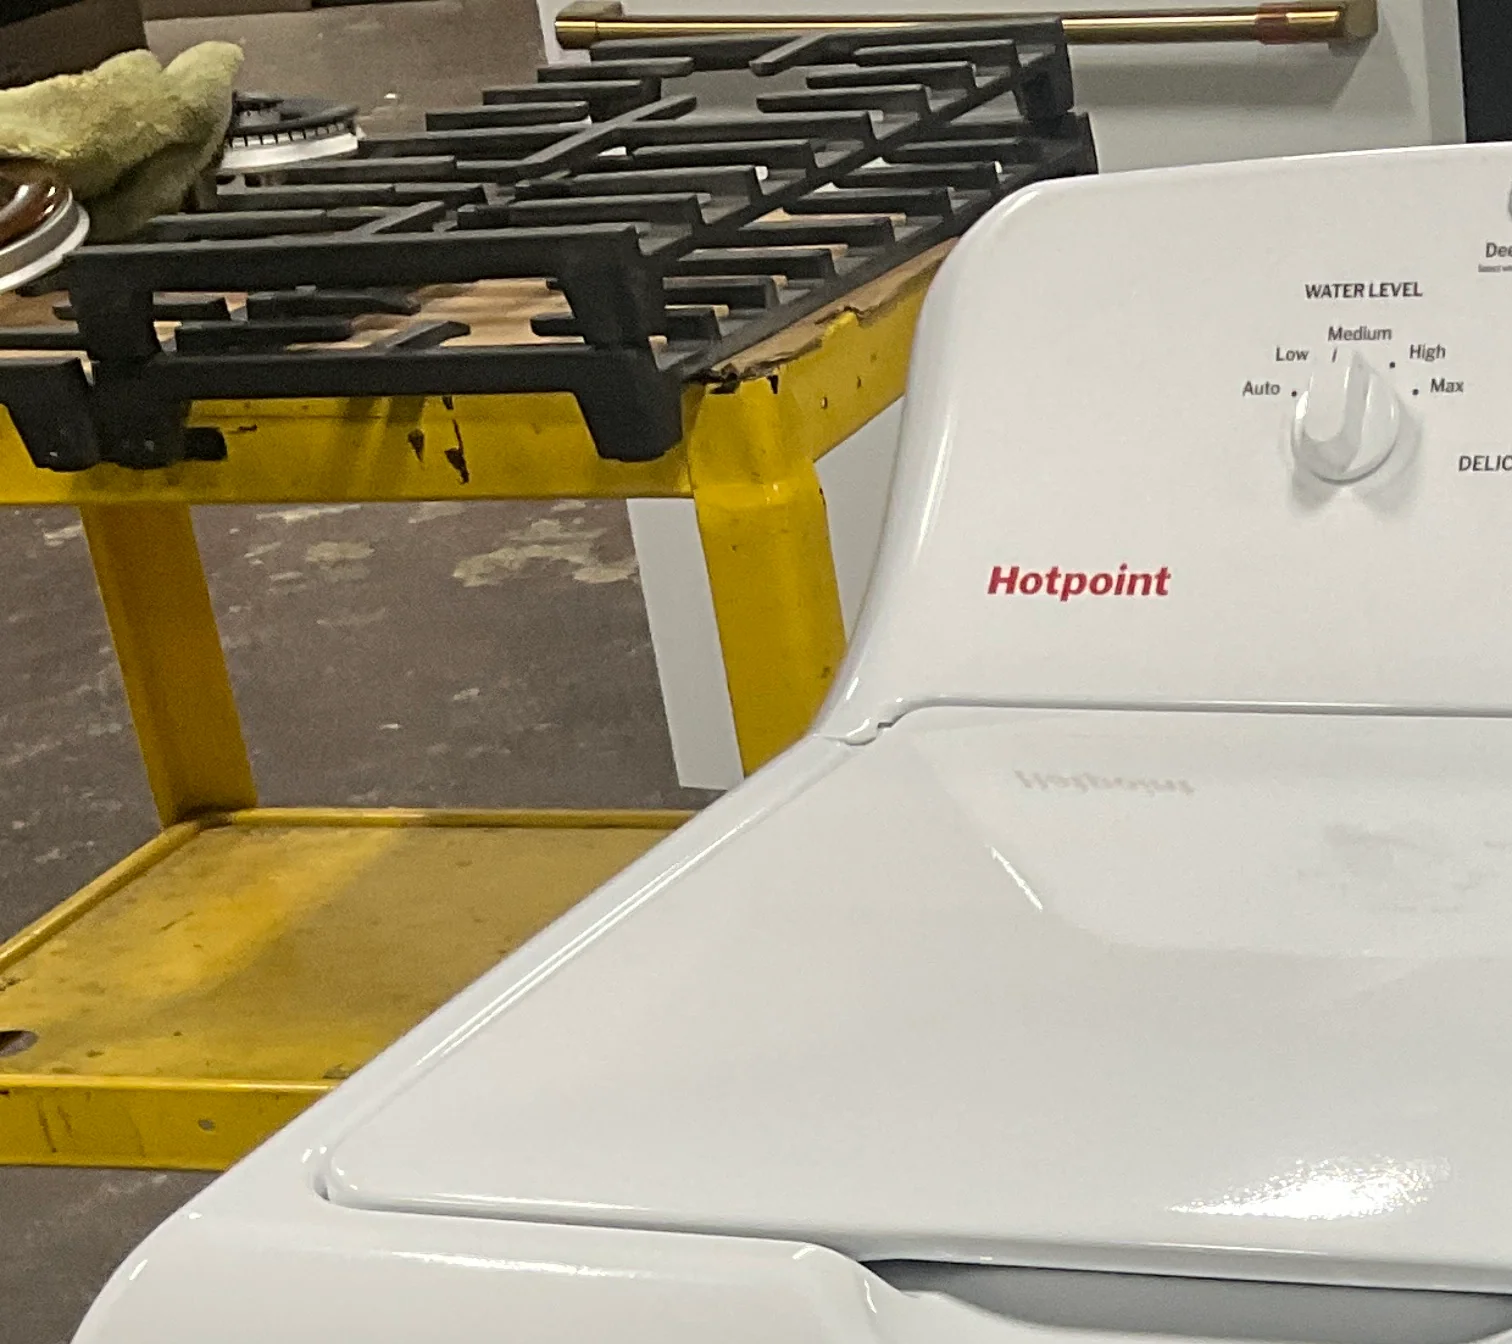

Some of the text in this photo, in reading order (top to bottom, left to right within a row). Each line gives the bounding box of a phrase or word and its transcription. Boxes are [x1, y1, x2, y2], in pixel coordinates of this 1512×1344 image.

[1304, 281, 1424, 300] WATER LEVEL
[1327, 325, 1393, 342] Medium
[1275, 346, 1310, 362] Low
[1409, 343, 1446, 363] High
[1242, 380, 1281, 397] Auto
[1429, 377, 1464, 394] Max
[986, 562, 1172, 602] Hotpoint
